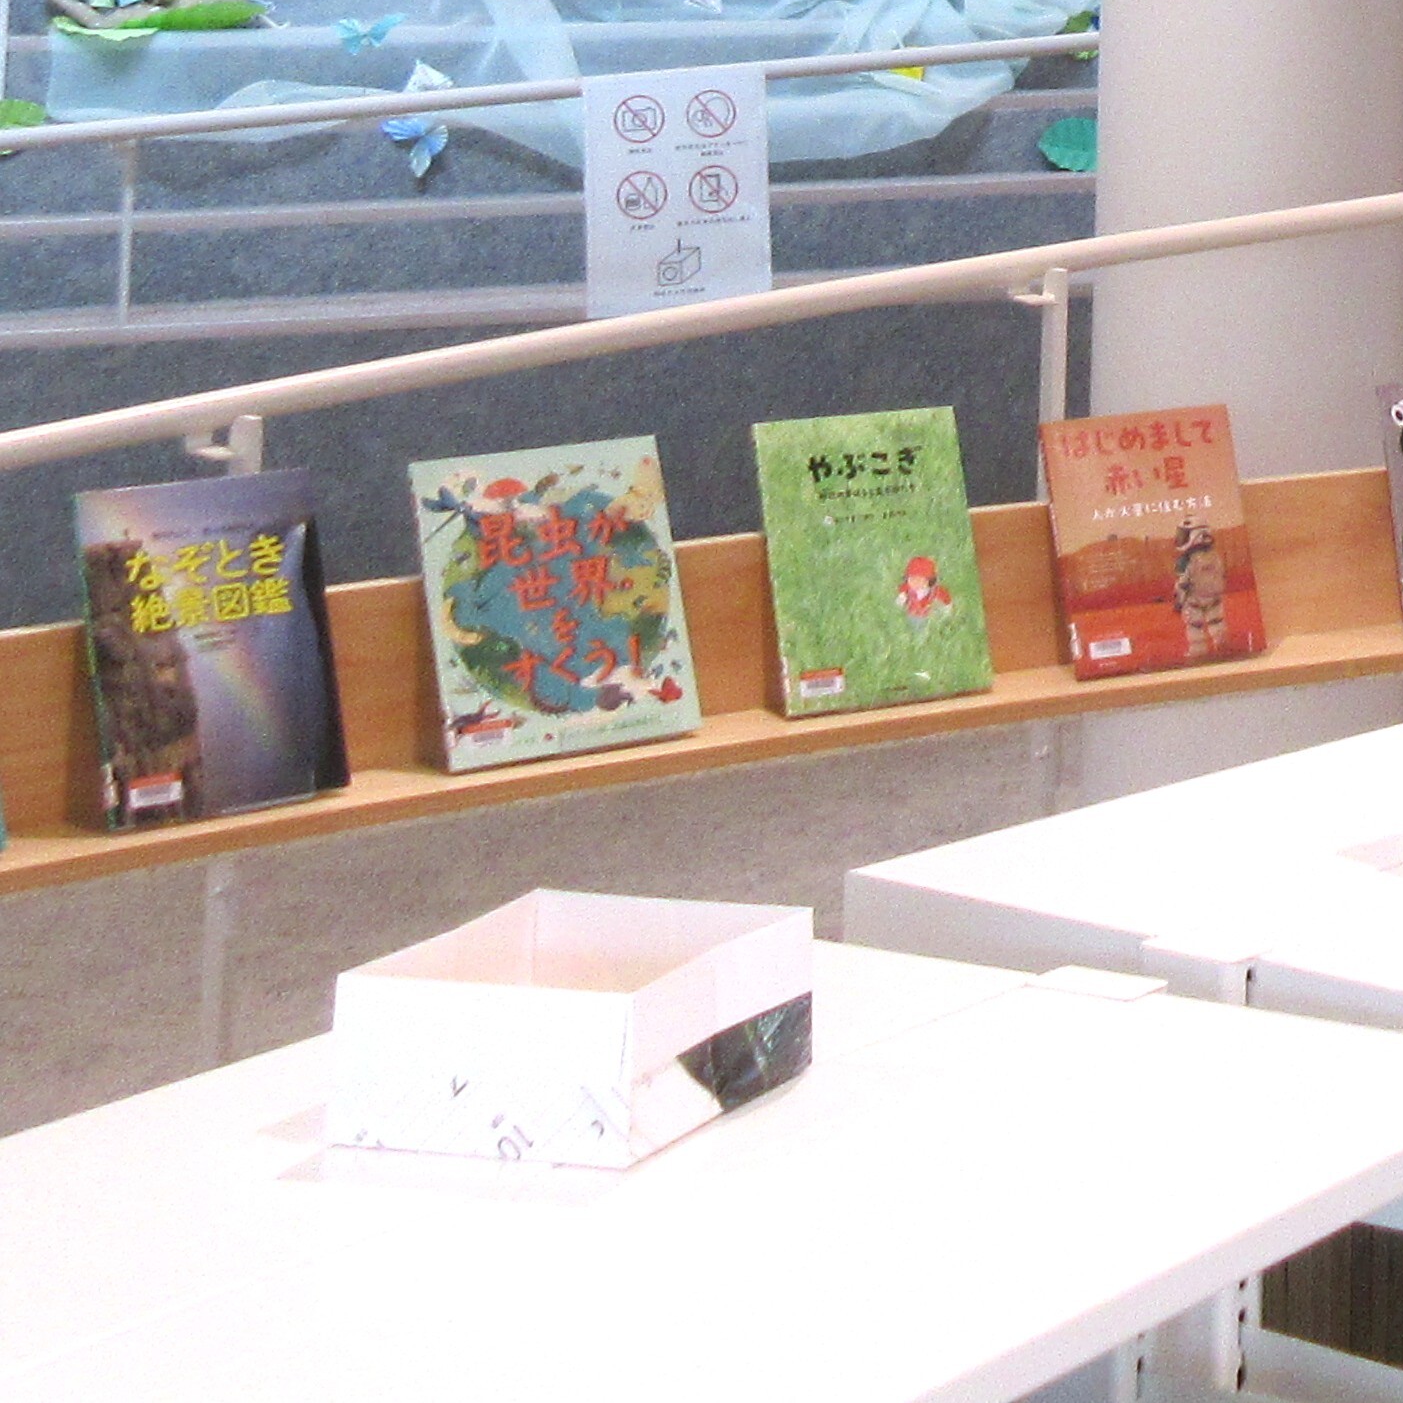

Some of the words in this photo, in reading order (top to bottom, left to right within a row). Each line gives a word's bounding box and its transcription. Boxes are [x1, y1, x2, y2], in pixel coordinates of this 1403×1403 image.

[808, 445, 922, 482] やぶこぎ
[1061, 420, 1212, 458] はじめまして
[125, 534, 285, 591] なぞとき
[479, 505, 629, 569] 昆虫が
[130, 576, 294, 633] 絶景図鑑
[508, 555, 617, 612] 世界
[552, 608, 580, 644] を
